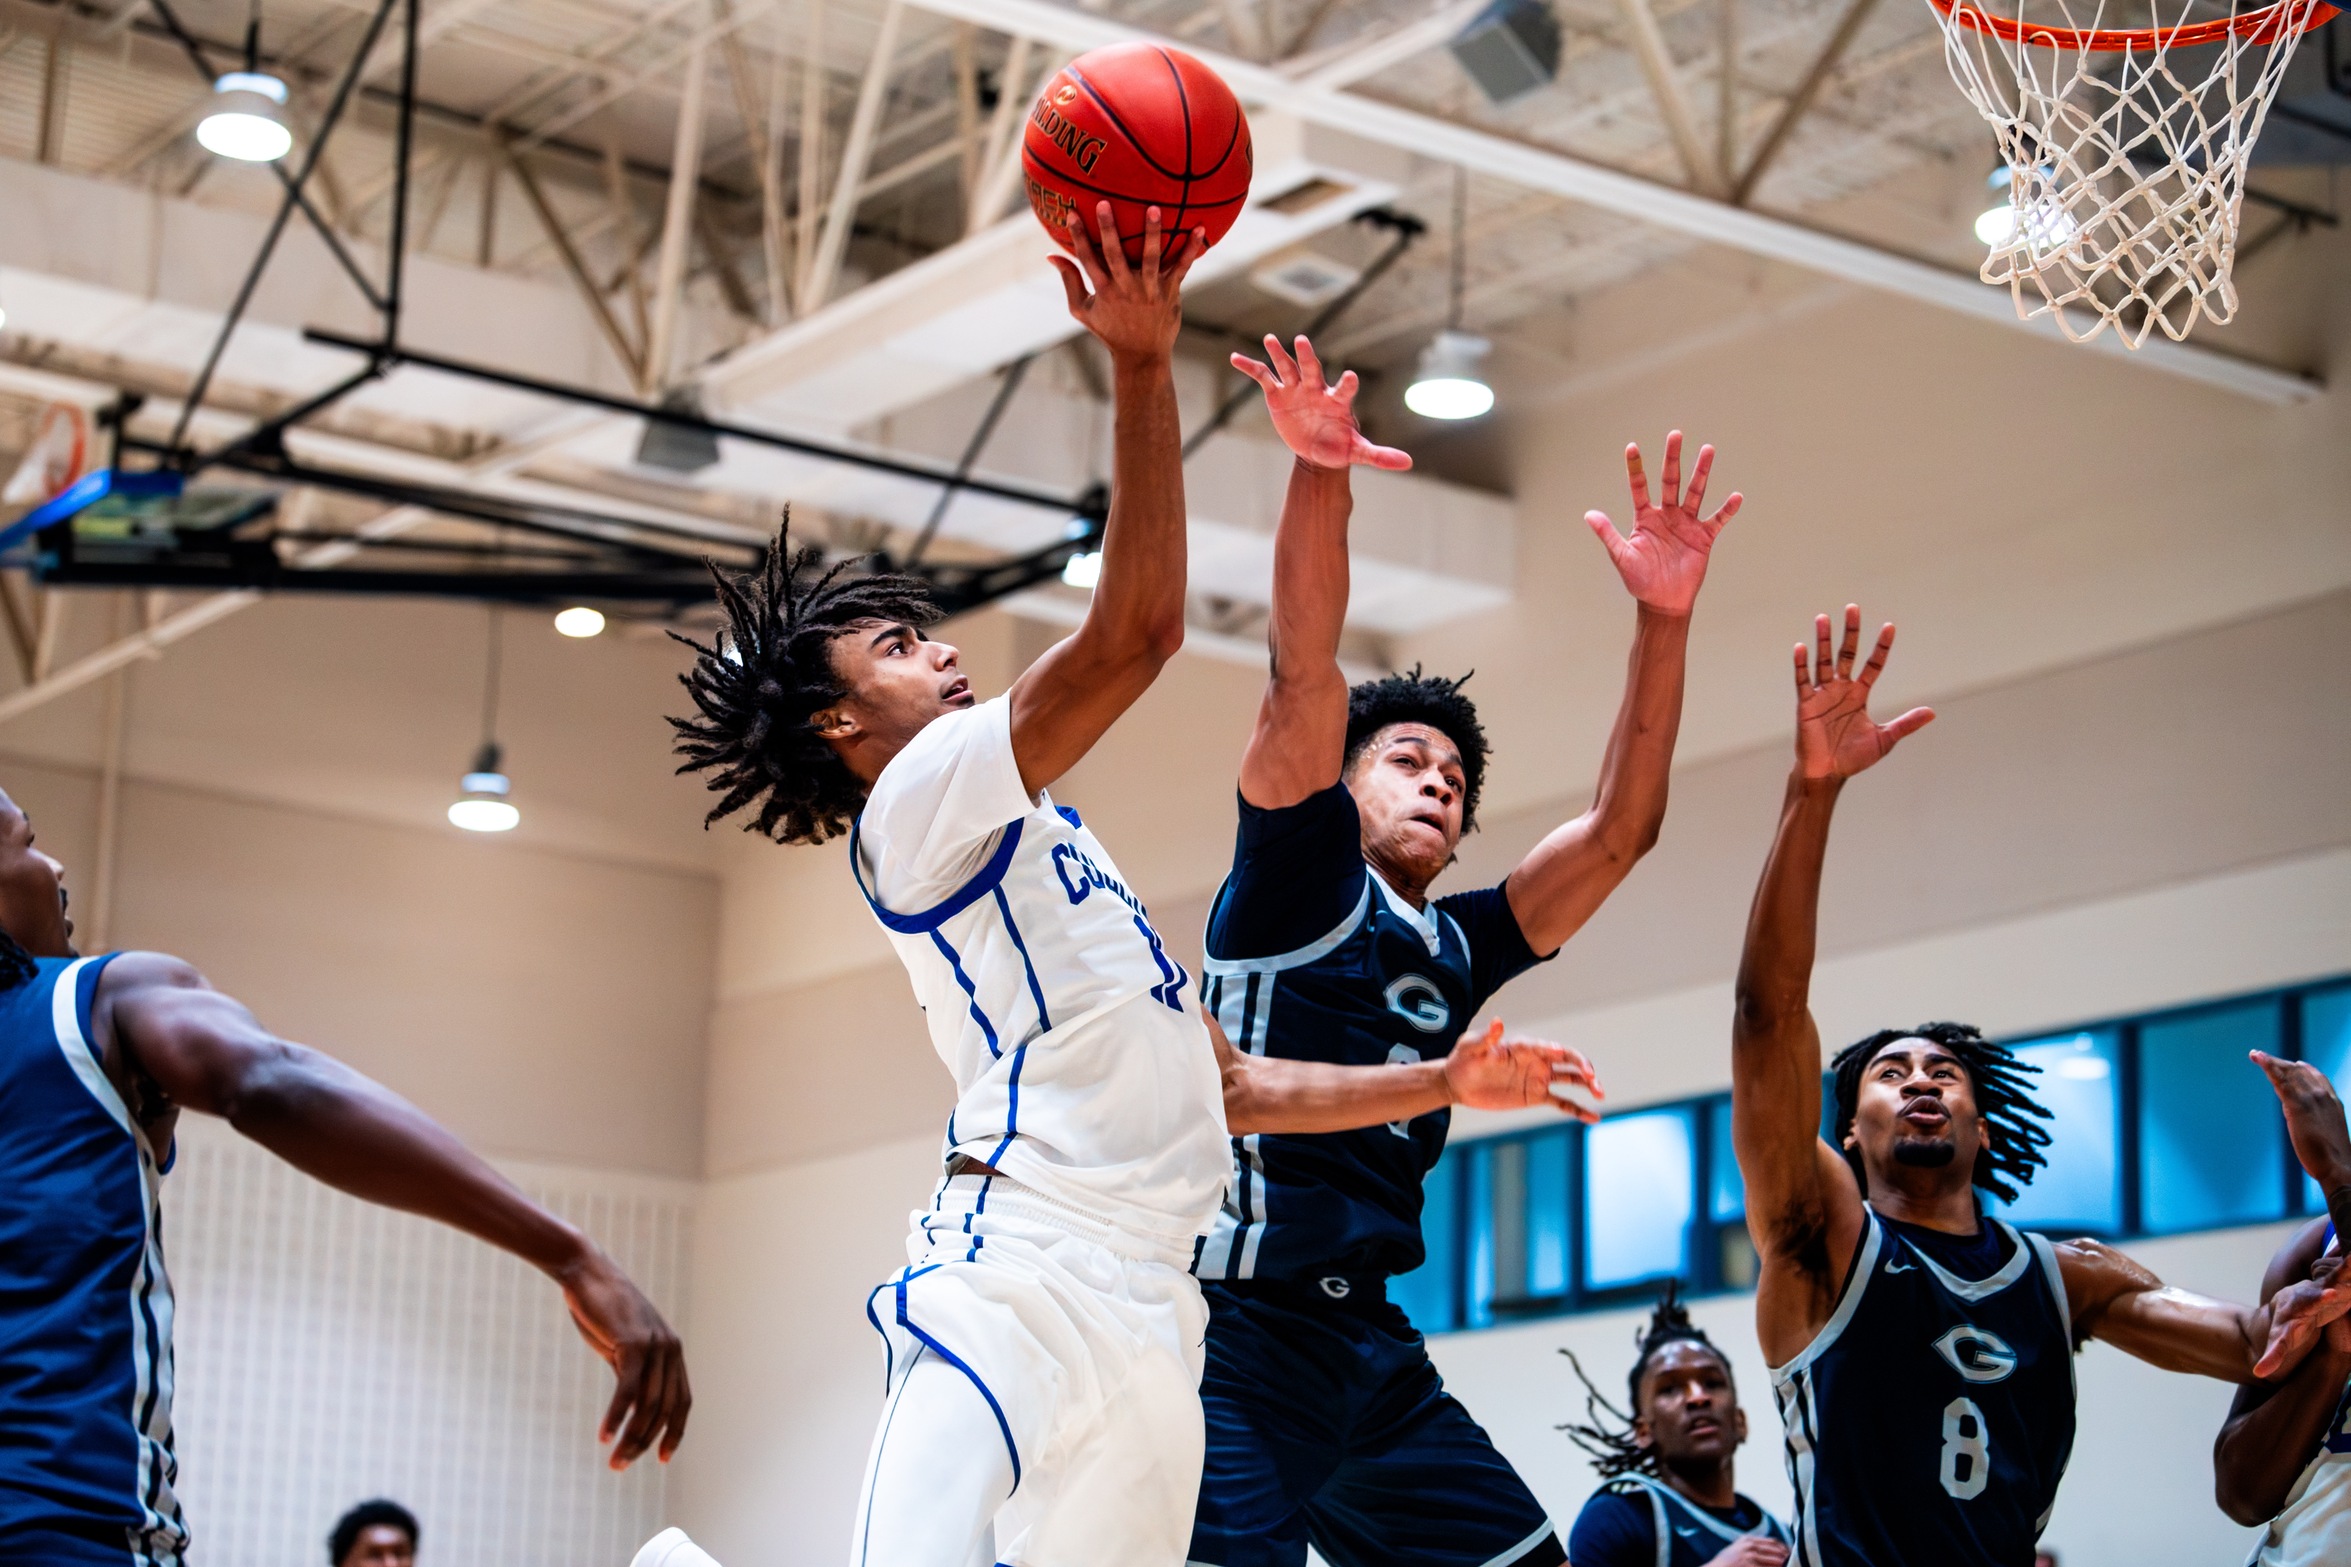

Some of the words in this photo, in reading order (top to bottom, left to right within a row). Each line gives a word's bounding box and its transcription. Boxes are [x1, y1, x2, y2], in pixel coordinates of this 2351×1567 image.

[1382, 972, 1450, 1034] G
[1319, 1277, 1350, 1298] G
[1931, 1323, 2018, 1384] G
[1939, 1396, 1990, 1501] 8
